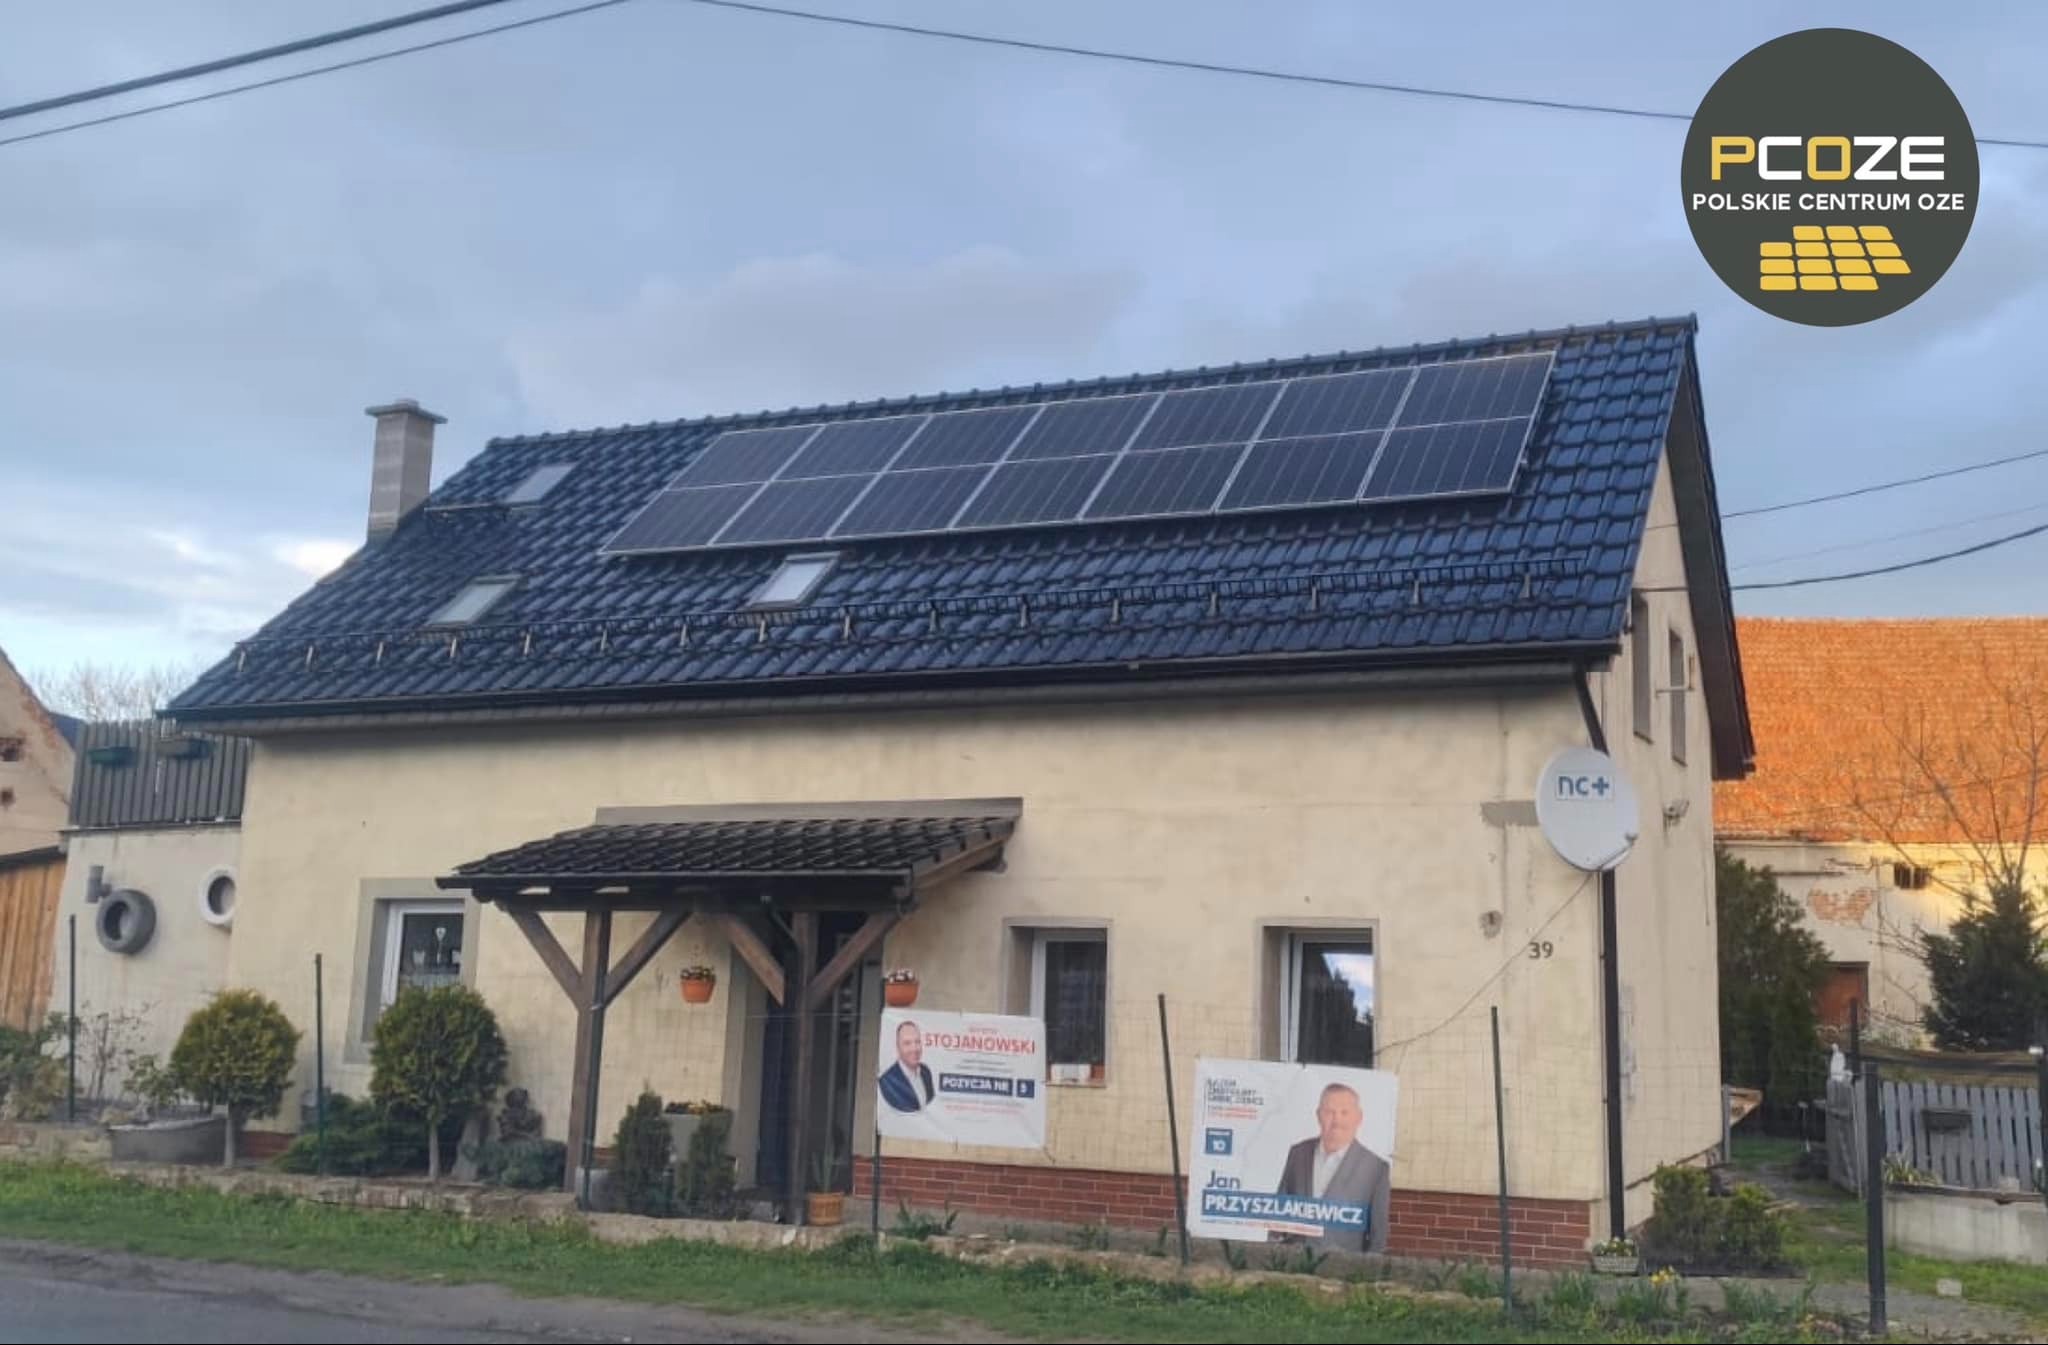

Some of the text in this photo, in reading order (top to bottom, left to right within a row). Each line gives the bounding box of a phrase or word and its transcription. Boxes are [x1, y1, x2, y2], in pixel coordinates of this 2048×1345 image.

[1557, 775, 1610, 796] nc+
[1527, 941, 1555, 959] 39
[924, 1032, 1036, 1055] STOJANOWSKI
[942, 1077, 992, 1089] POZYCJA
[1213, 1140, 1226, 1152] 10
[1206, 1170, 1241, 1189] Jan
[1204, 1193, 1364, 1224] PRZYSZLAKIEWICZ
